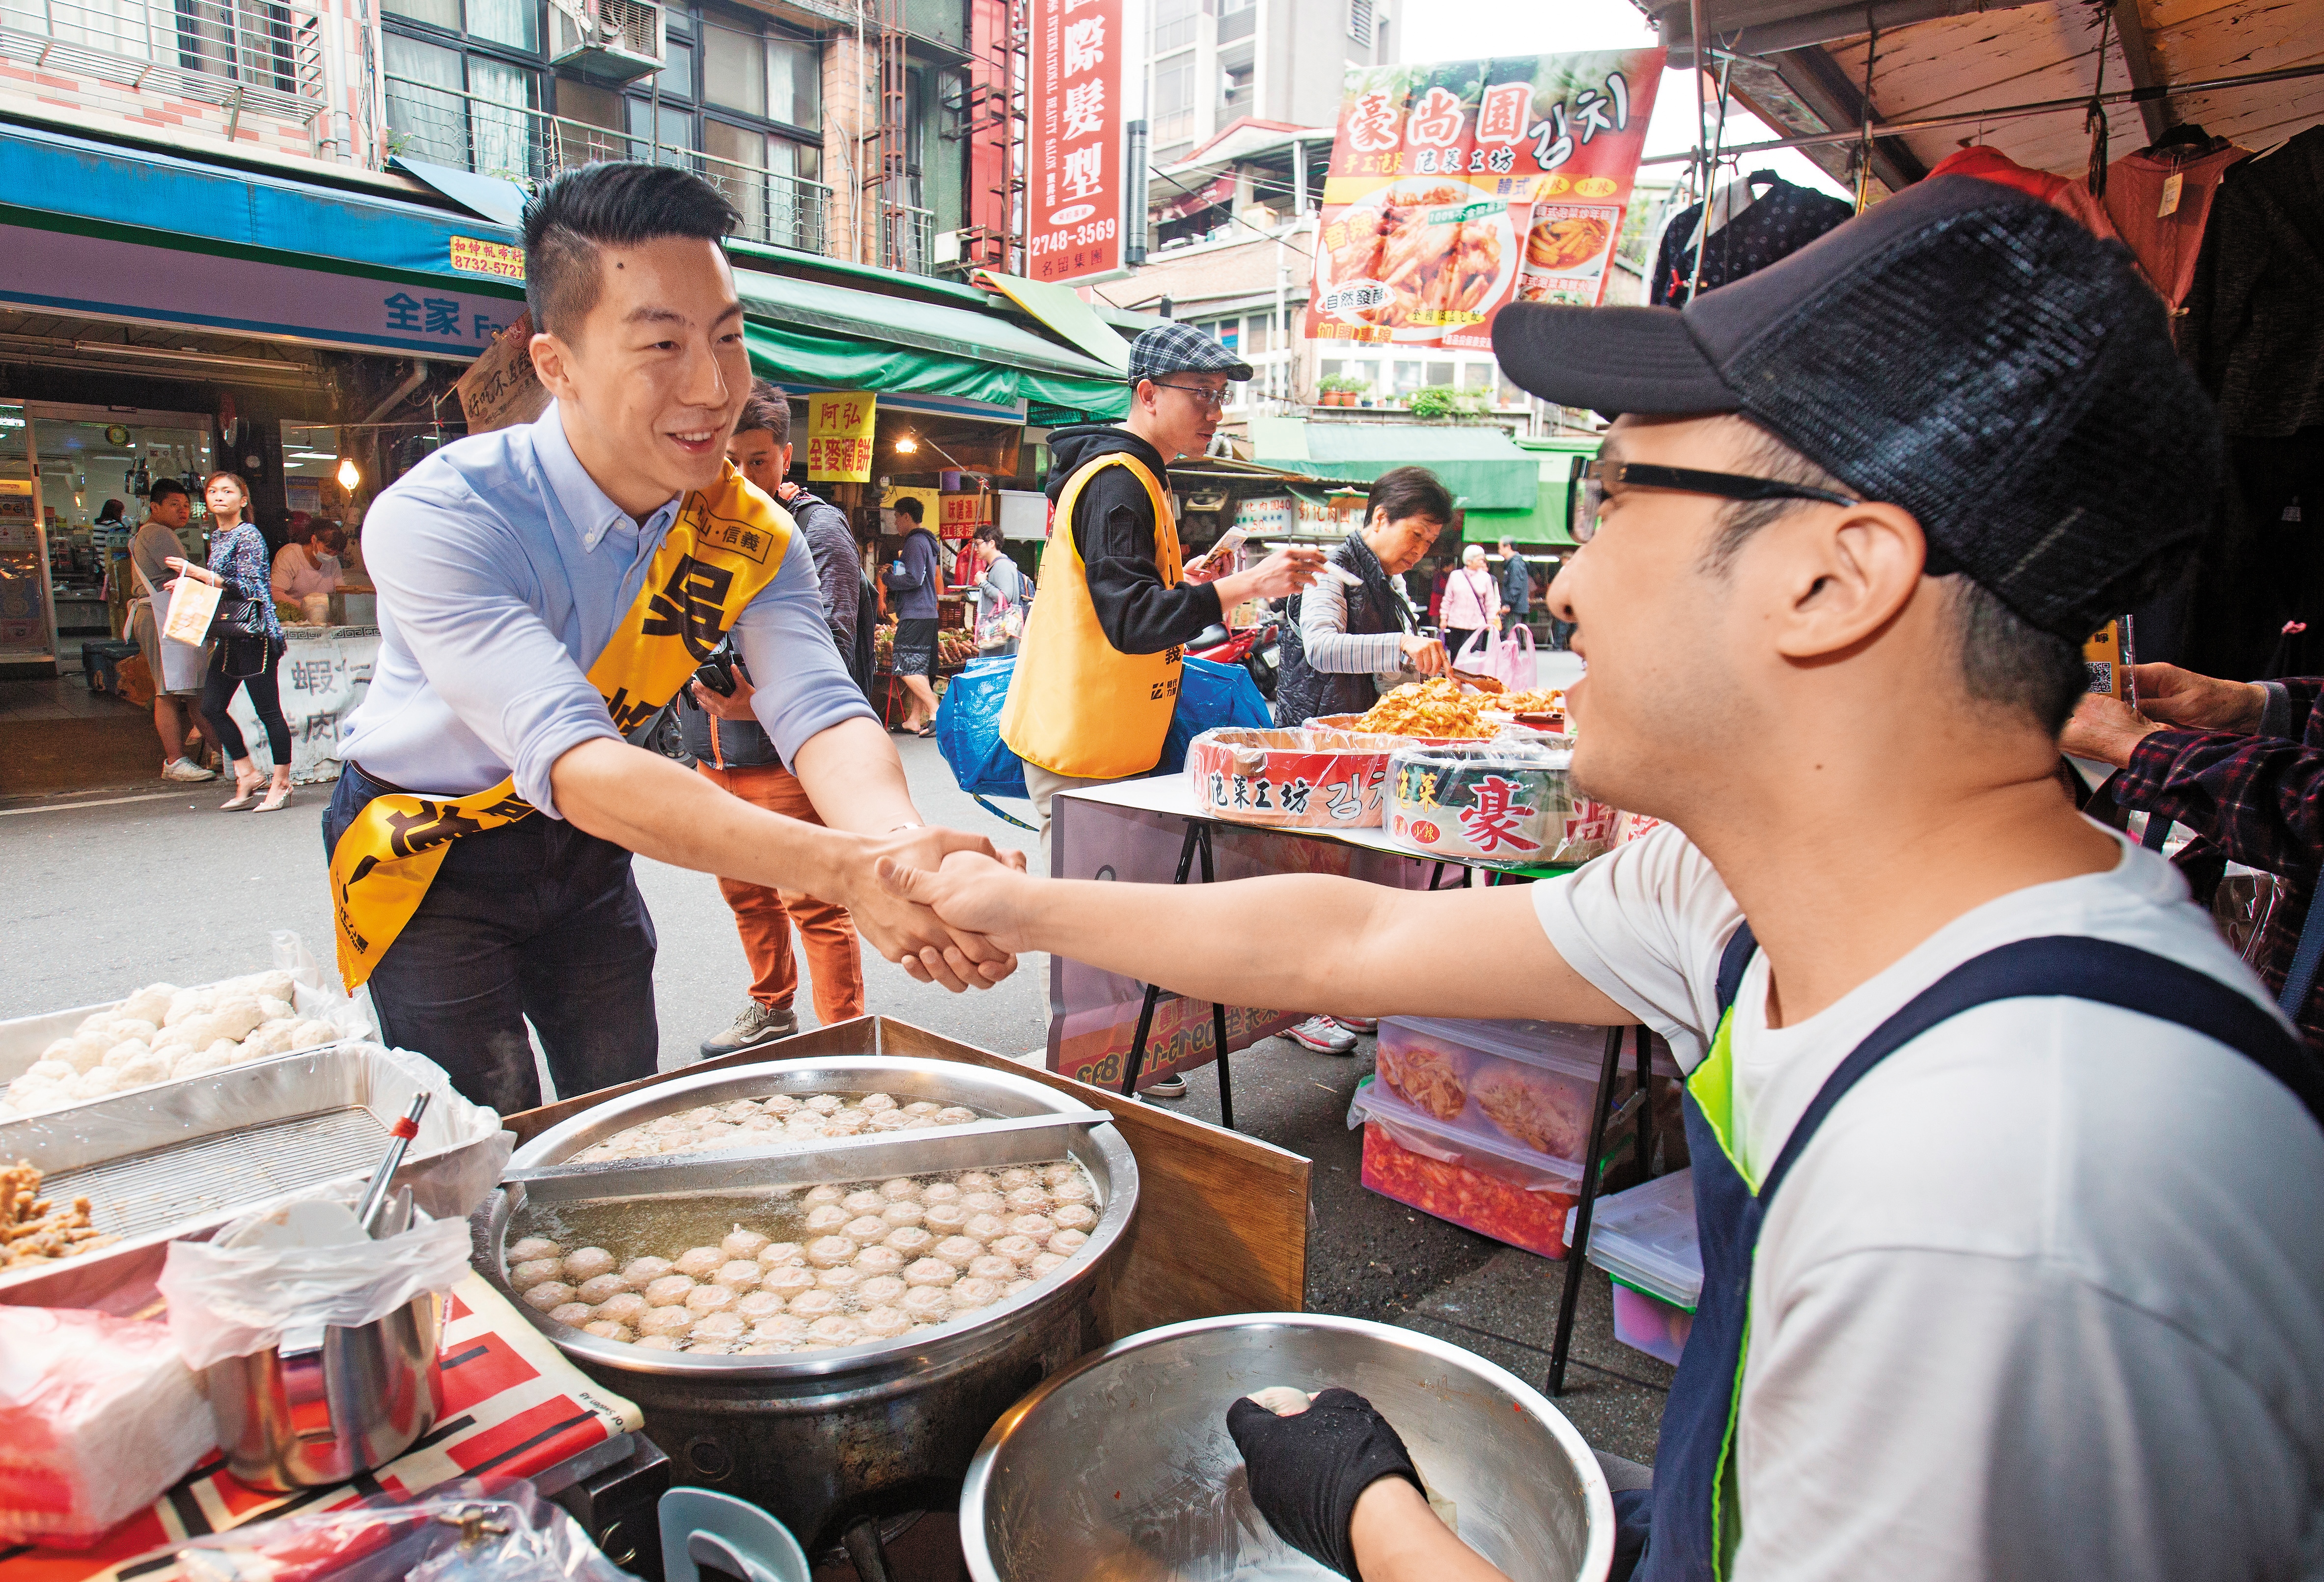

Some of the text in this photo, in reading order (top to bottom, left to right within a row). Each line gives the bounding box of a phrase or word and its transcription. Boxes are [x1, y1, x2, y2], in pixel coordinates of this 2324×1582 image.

[1046, 14, 1059, 94] INTERNATIONAL
[1046, 96, 1057, 135] BEAUTY
[1062, 0, 1106, 202] 際髮型
[1349, 83, 1532, 150] 豪尚園
[1528, 72, 1630, 170] 김치
[1045, 138, 1057, 170] SALON
[1415, 147, 1516, 174] 泡菜工坊
[1032, 218, 1115, 256] 2748-3569
[455, 255, 524, 278] 8732-5727
[384, 292, 462, 336] 全家
[820, 402, 861, 430] 阿弘
[941, 524, 981, 538] 江家涼
[291, 656, 372, 696] 蝦仁
[1210, 771, 1311, 815] 泡菜工坊
[1395, 769, 1442, 813] 泡菜
[1414, 824, 1436, 841] 小辣
